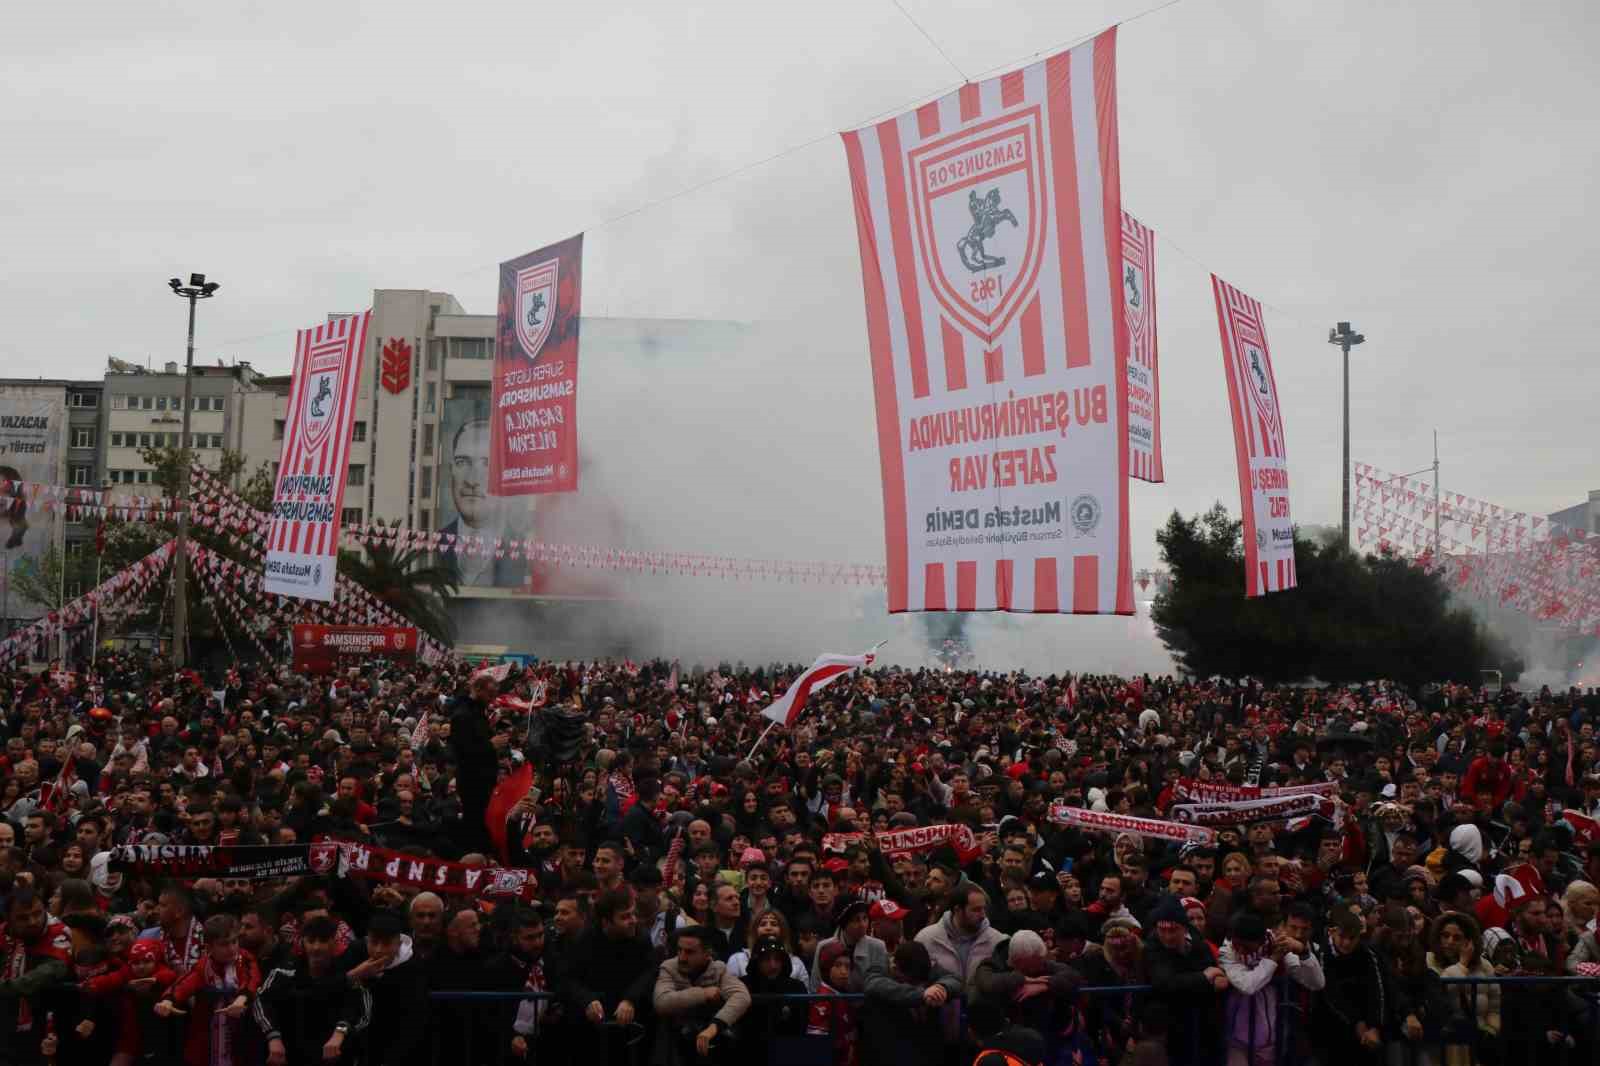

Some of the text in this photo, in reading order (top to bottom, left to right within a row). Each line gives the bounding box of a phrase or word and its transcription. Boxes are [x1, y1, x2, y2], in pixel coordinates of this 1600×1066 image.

[1, 415, 49, 429] YAZACAK
[323, 633, 386, 646] SAMSUNSPOR
[1079, 811, 1188, 839] SAMSUNSPOR
